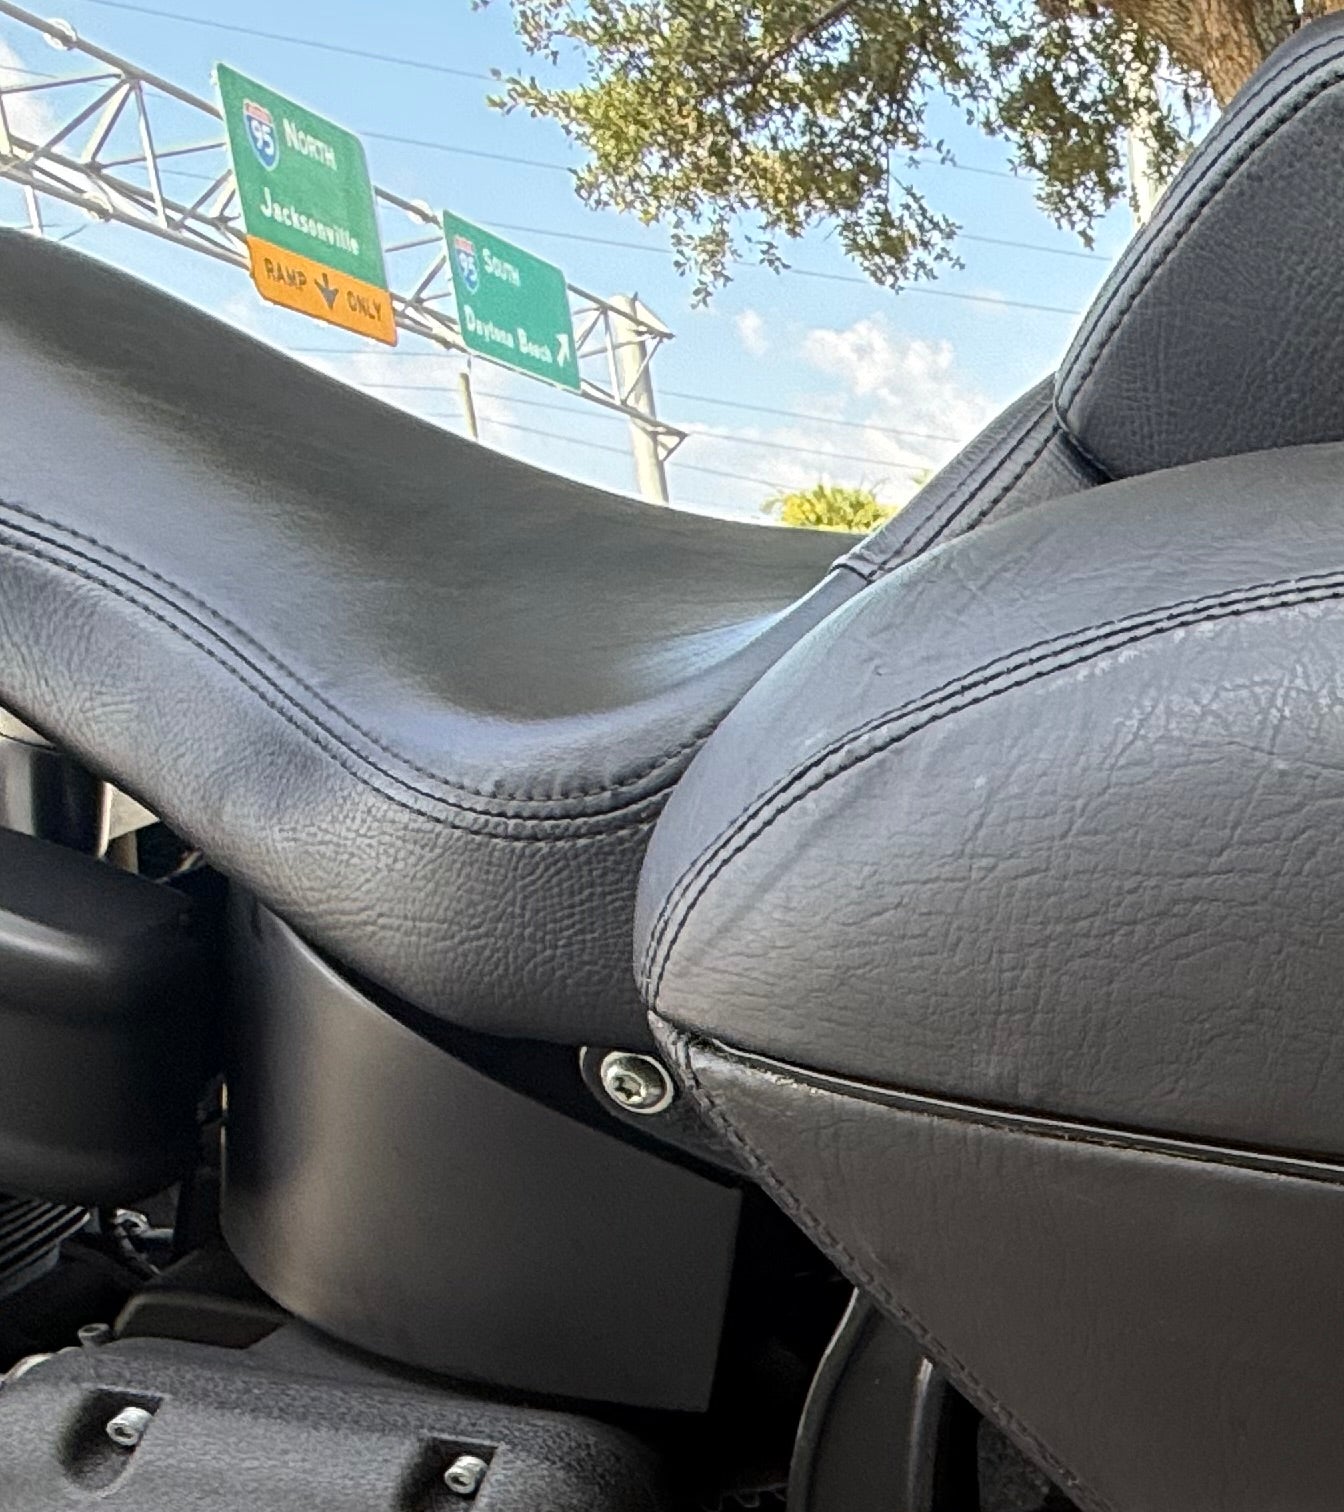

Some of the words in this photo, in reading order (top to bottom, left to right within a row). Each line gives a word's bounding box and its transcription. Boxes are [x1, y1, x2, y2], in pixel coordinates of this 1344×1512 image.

[250, 119, 275, 156] 95
[260, 187, 360, 255] Jacksonville
[264, 257, 307, 290] RAMP
[346, 290, 382, 321] ONLY
[463, 304, 515, 349] Daytona
